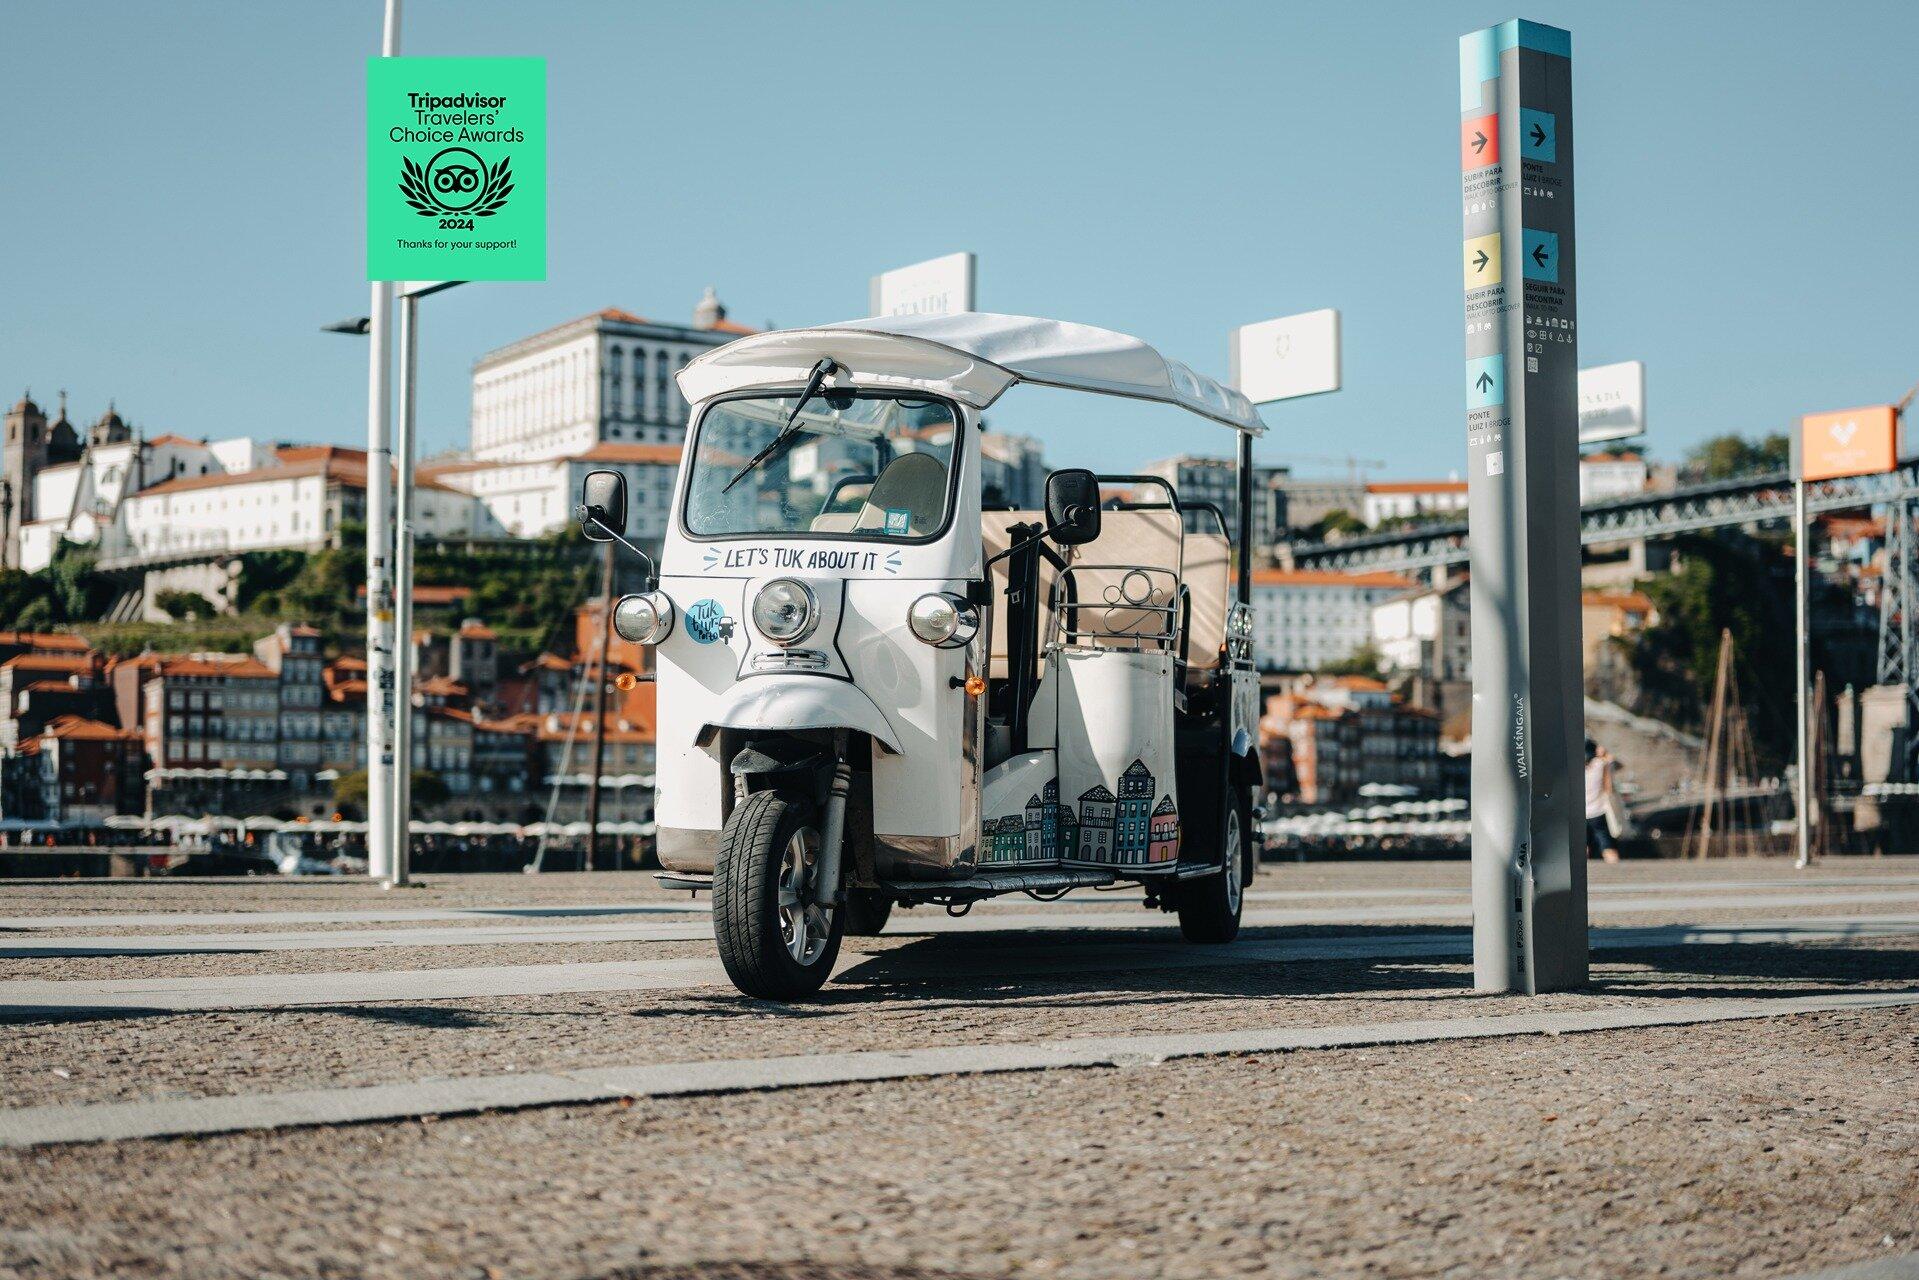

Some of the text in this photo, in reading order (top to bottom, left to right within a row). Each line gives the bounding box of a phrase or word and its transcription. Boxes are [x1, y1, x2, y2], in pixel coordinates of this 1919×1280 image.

[1464, 166, 1503, 183] SUBIR PARA
[1523, 162, 1544, 173] PONTE
[1464, 177, 1502, 193] DESCOBRIR
[1466, 286, 1505, 302] SUBIR PARA
[1466, 297, 1503, 312] DESCOBRIR
[1468, 410, 1490, 421] PONTE
[1468, 422, 1484, 432] LUIZ
[1489, 417, 1511, 429] BRIDGE
[724, 547, 878, 570] LET'S TUK ABOUT IT
[692, 598, 719, 620] Tuk
